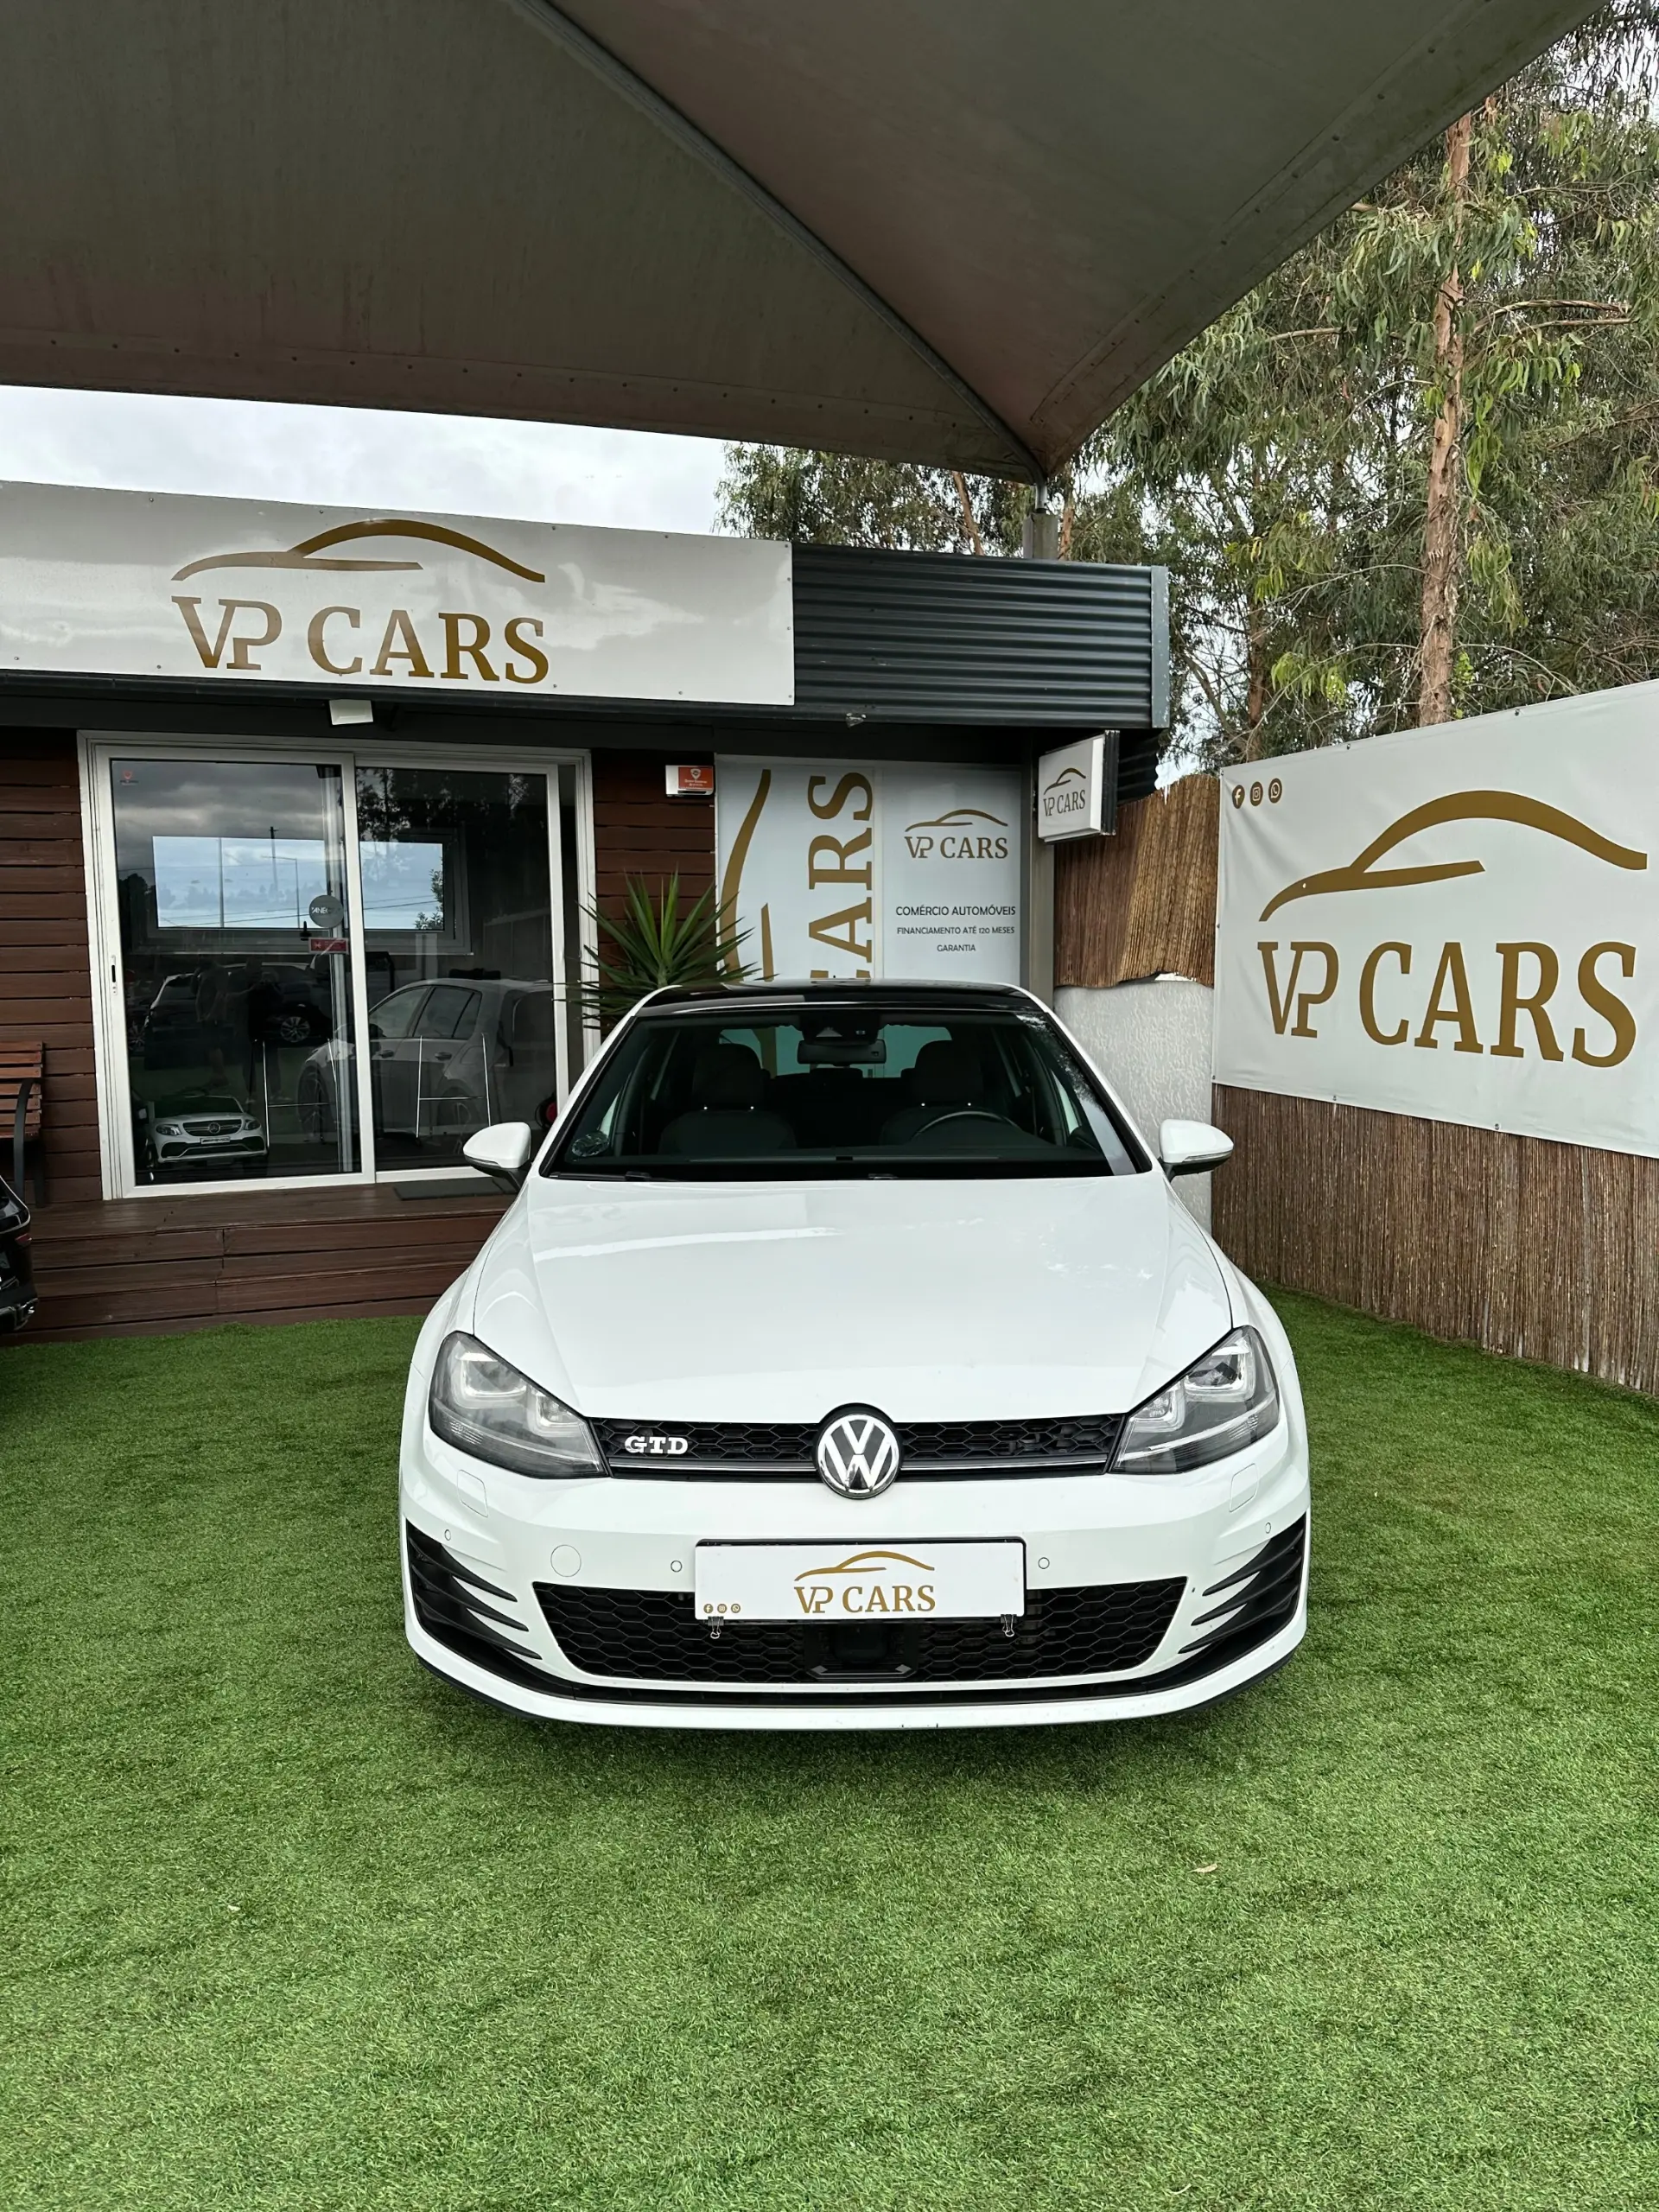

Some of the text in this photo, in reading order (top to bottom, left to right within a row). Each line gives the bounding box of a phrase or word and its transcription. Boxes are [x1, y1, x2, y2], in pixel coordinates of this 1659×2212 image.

[171, 595, 550, 684] VP CARS
[1043, 789, 1086, 817] VP CARS
[904, 836, 1008, 859] VP CARS
[807, 772, 874, 979] ARS
[895, 905, 1016, 916] COMÉRCIO AUTOMÓVEIS
[963, 925, 976, 934] ATÉ
[1257, 941, 1637, 1068] VP CARS
[624, 1435, 689, 1455] GTD
[794, 1585, 937, 1614] VP CARS
